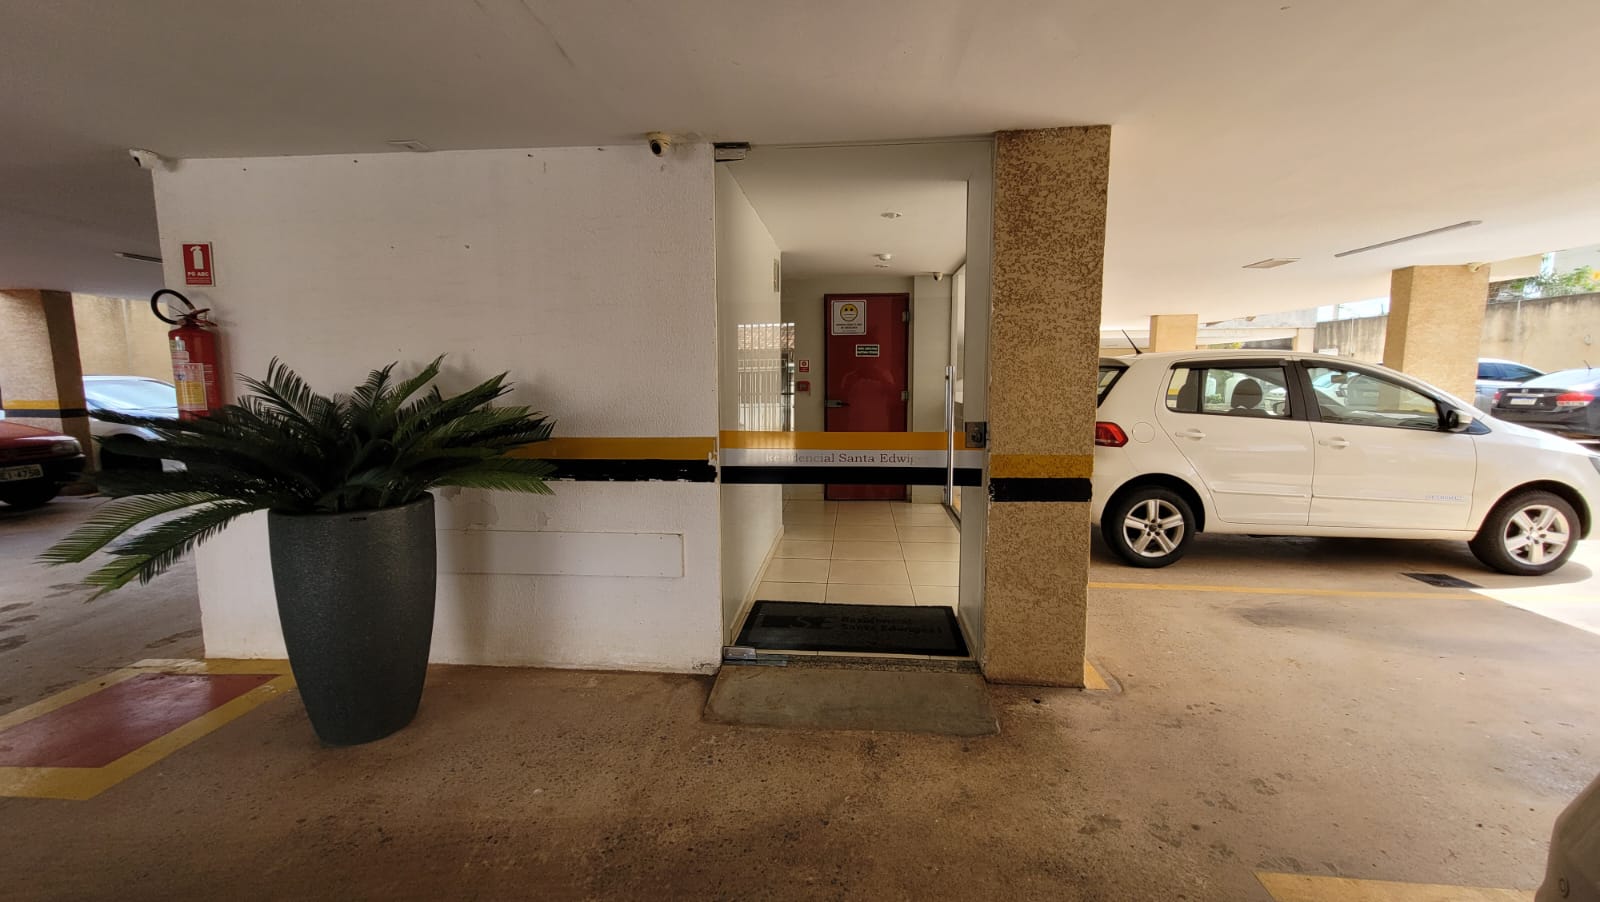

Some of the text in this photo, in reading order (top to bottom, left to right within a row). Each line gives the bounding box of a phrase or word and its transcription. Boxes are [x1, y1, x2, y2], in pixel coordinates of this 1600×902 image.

[766, 453, 919, 466] Reidencial Santa Edwi
